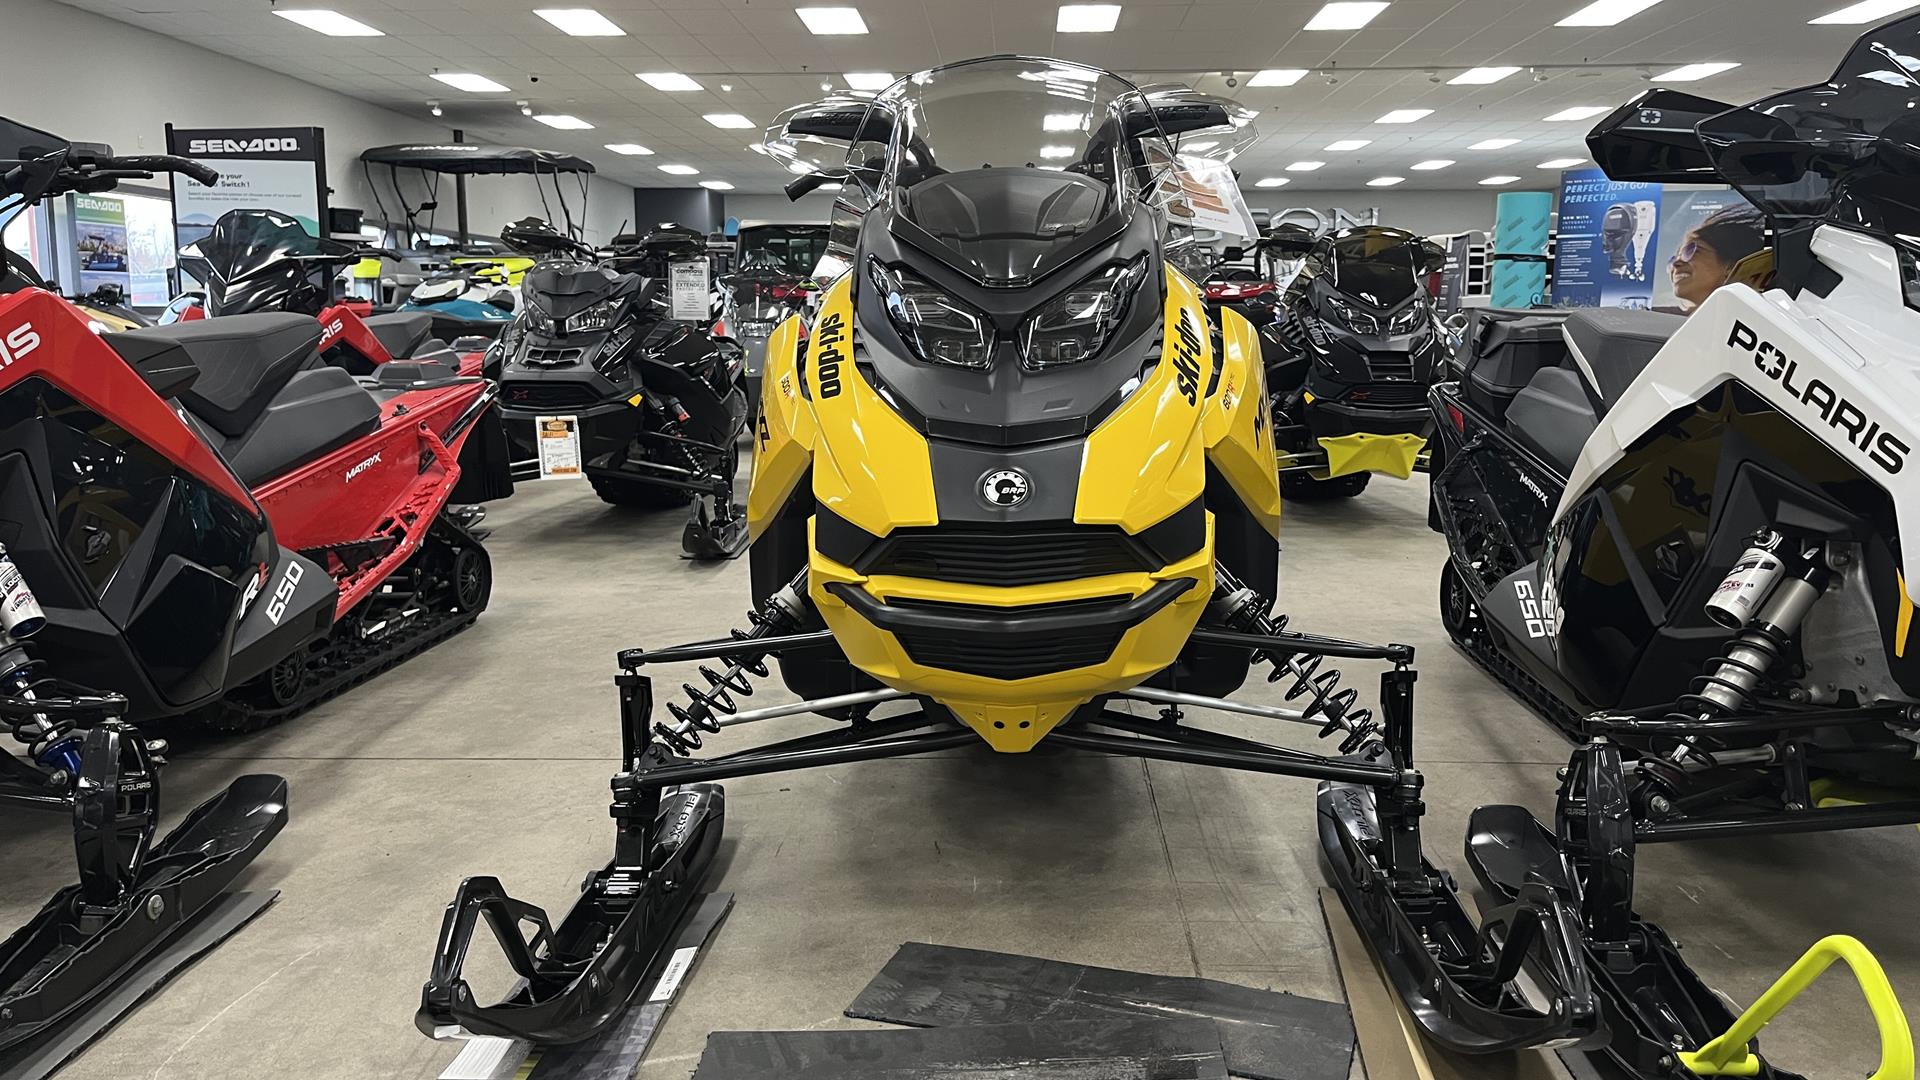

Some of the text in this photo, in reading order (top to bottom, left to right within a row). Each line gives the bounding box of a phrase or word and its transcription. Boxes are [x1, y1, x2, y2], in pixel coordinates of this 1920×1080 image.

[1565, 184, 1605, 193] PERFECT
[1607, 182, 1627, 192] JUST
[819, 312, 845, 399] ski-doo
[1173, 307, 1201, 407] ski-doo
[1727, 319, 1911, 474] POLARIS
[345, 452, 382, 483] MATRYX
[1520, 472, 1550, 508] MATRYX
[265, 560, 304, 625] 650
[1514, 580, 1546, 638] 650
[121, 782, 151, 792] POLARIS
